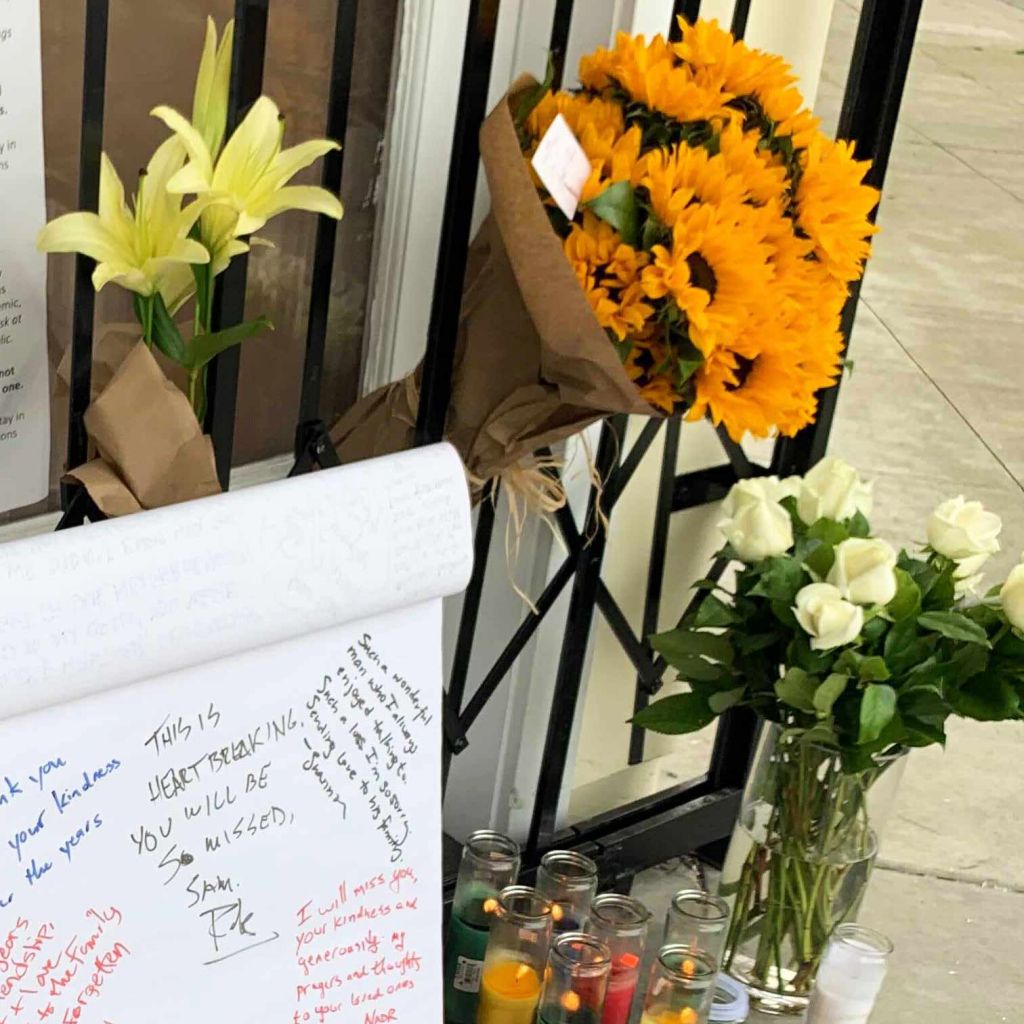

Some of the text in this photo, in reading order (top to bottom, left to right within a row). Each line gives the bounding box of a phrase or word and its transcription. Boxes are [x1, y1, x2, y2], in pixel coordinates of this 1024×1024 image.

[7, 140, 17, 151] in
[13, 314, 22, 325] at
[1, 382, 24, 394] one.
[16, 410, 26, 421] in
[392, 673, 434, 726] wonderful
[144, 702, 222, 757] THIS IS
[28, 756, 68, 791] you
[8, 809, 47, 862] your
[51, 757, 123, 815] kindness
[130, 761, 272, 854] YOU WILL BE
[25, 858, 54, 886] the
[59, 812, 104, 863] years
[296, 899, 314, 927] I
[317, 879, 348, 916] will
[353, 873, 386, 898] miss
[295, 922, 328, 957] your
[333, 905, 392, 932] kindness
